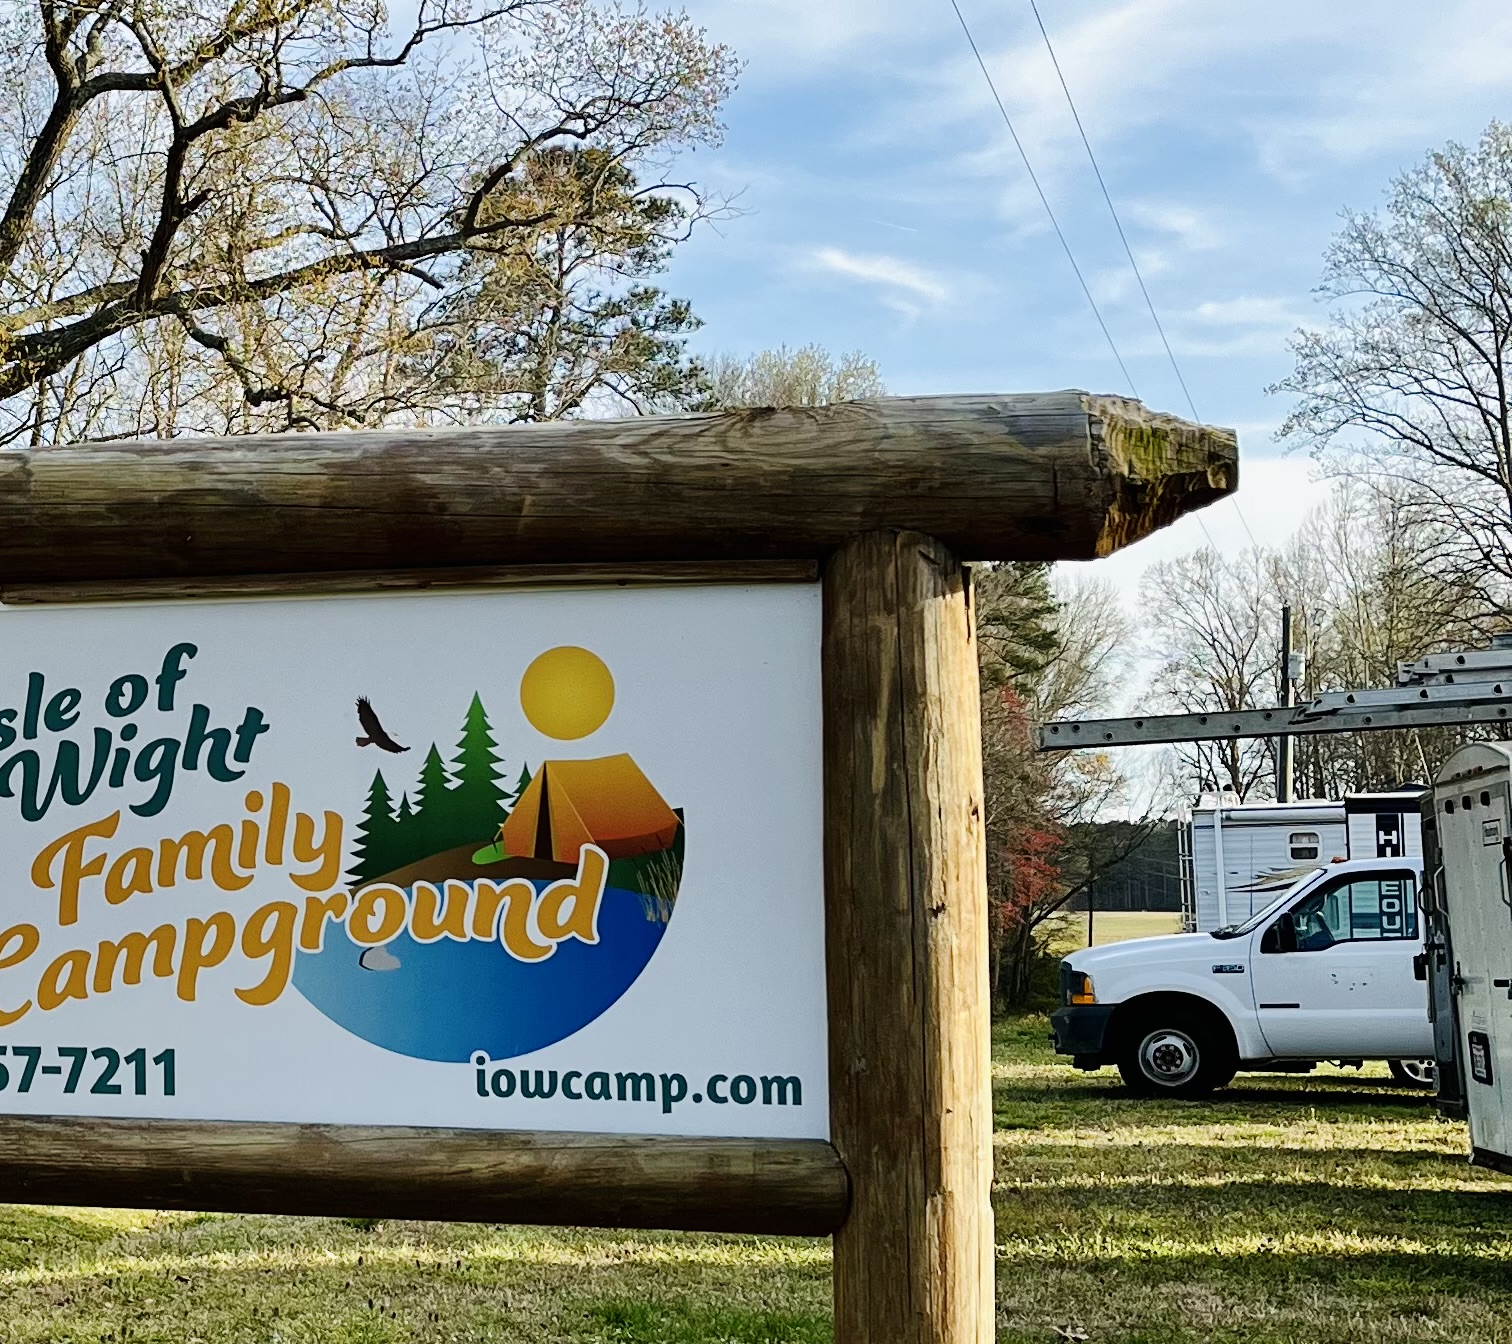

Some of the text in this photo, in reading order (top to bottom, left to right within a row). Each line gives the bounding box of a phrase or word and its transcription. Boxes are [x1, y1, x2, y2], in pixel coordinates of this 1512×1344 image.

[104, 642, 199, 719] of
[30, 782, 344, 926] Family
[1378, 830, 1402, 937] HIEOU
[474, 1055, 804, 1115] iowcamp.com
